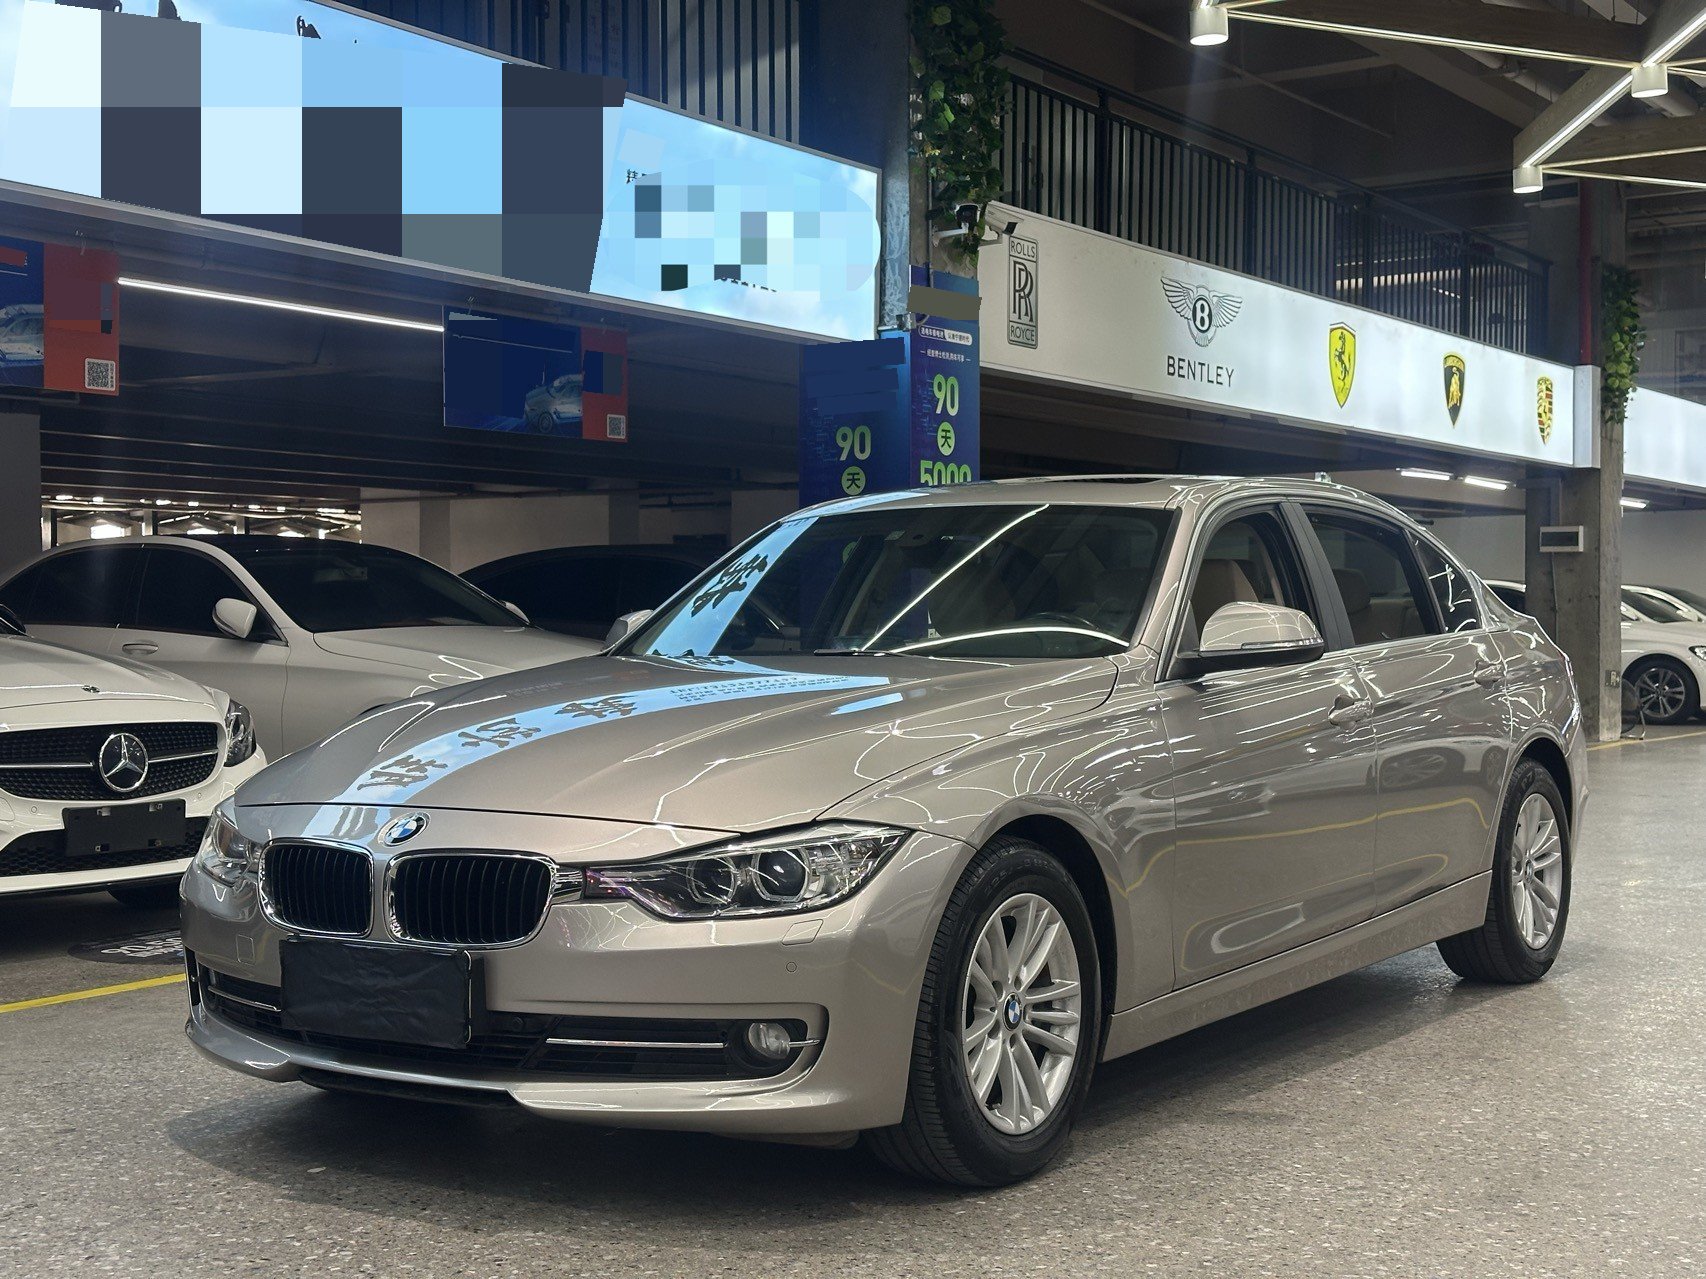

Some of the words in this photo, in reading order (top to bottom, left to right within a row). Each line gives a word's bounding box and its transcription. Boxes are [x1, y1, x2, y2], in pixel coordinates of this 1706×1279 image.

[1010, 240, 1037, 259] ROLLS
[1010, 325, 1035, 343] ROYCE
[1167, 355, 1234, 387] BENTLEY
[933, 374, 959, 416] 90
[835, 425, 872, 461] 90
[941, 429, 952, 449] 天
[846, 473, 861, 490] 天
